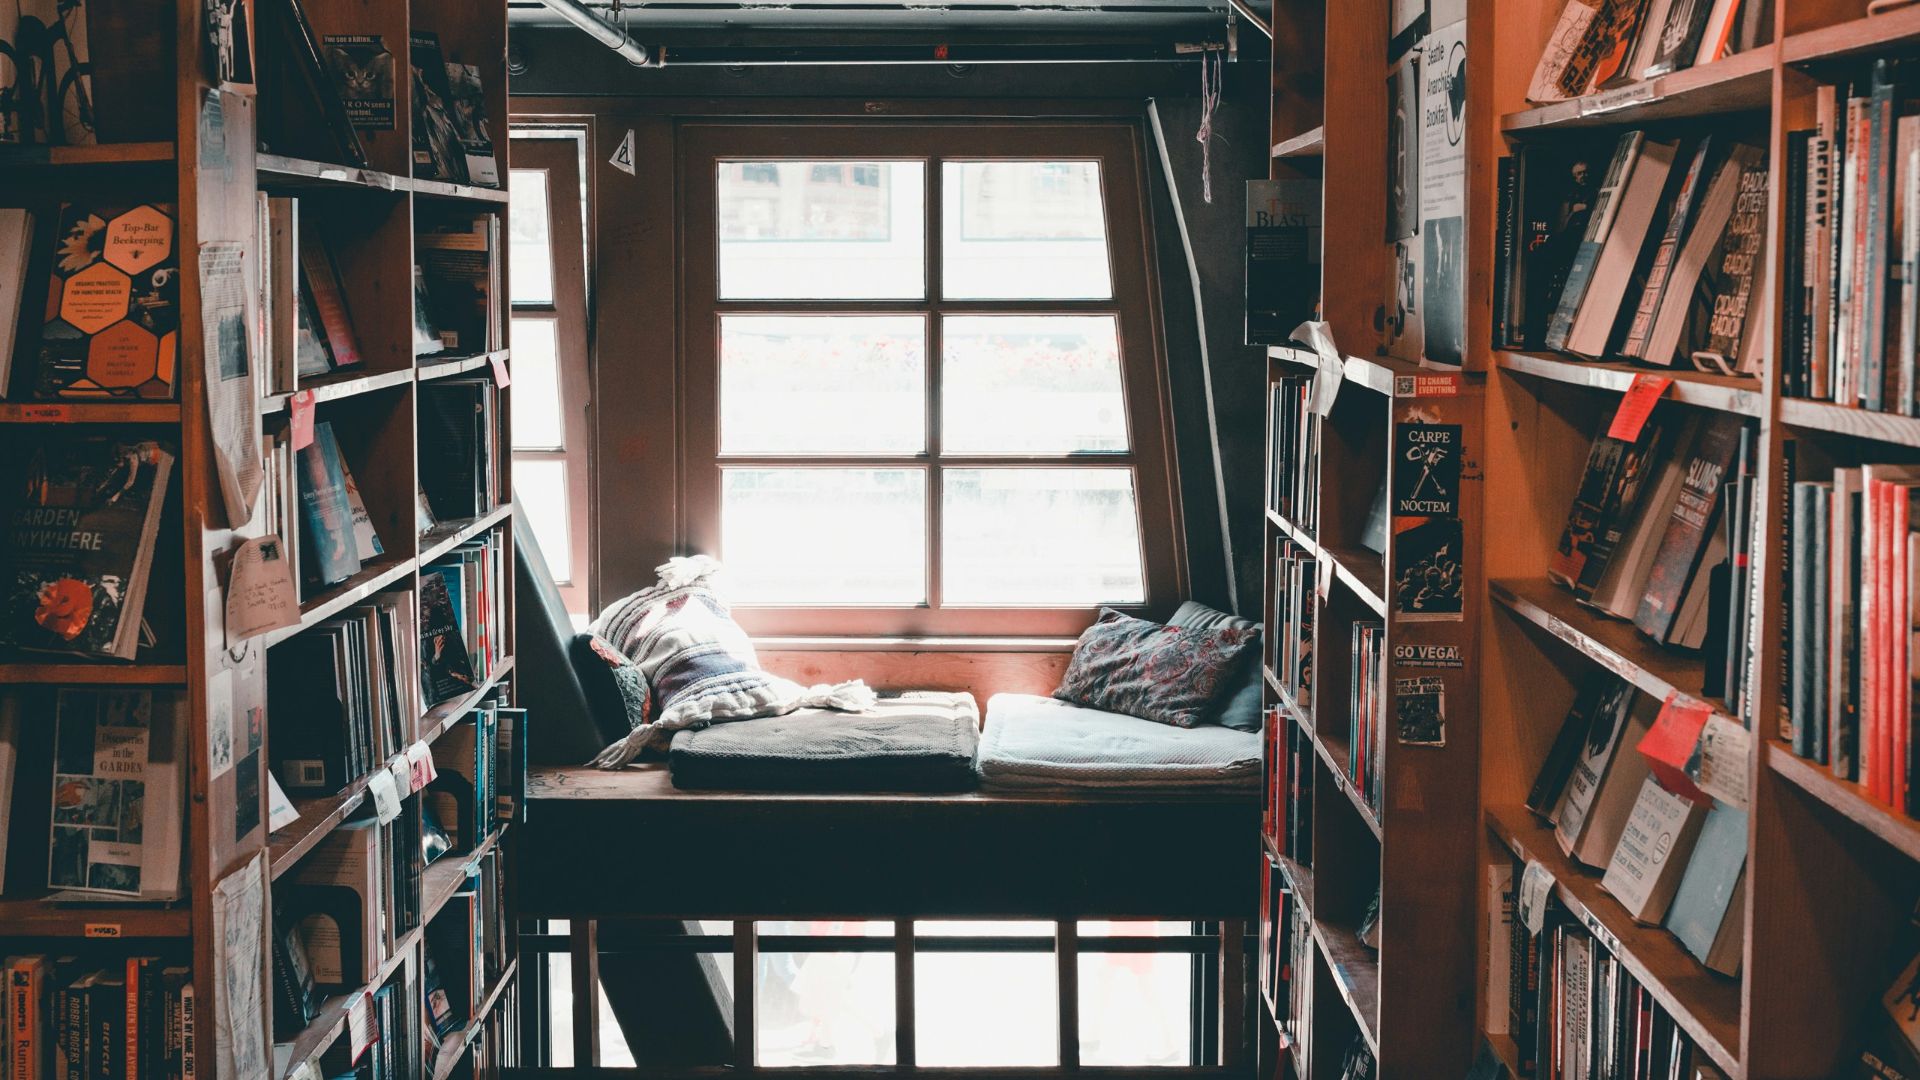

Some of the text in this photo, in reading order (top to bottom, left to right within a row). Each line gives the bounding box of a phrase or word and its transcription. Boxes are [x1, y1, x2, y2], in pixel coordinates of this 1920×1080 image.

[1428, 41, 1444, 66] Seattle
[1427, 70, 1454, 97] Anarchist
[1426, 104, 1448, 128] Bookfair
[1266, 198, 1304, 216] THE
[1256, 210, 1312, 228] BLAST
[1532, 222, 1548, 231] THE
[122, 223, 159, 234] Top-Bar
[113, 236, 164, 246] Beekeeping
[1418, 377, 1452, 386] TO CHANGE
[1418, 386, 1456, 394] EVERYTHING
[1408, 430, 1451, 443] CARPE
[1686, 456, 1722, 494] SLUMS
[1400, 500, 1450, 512] NOCTEM
[12, 508, 80, 527] GARDEN
[9, 530, 103, 550] ANYWHERE
[1395, 646, 1414, 658] GO
[1746, 656, 1754, 717] TORONTO
[102, 733, 144, 744] Discoveries
[113, 747, 134, 758] in the
[100, 761, 143, 772] GARDEN
[1641, 789, 1681, 820] LOCKING UP
[1626, 858, 1644, 880] America
[70, 997, 80, 1028] ROBBIE
[127, 992, 136, 1023] HEAVEN
[184, 997, 193, 1022] WHAT'S
[127, 1026, 136, 1034] IS
[184, 1024, 193, 1032] MY
[70, 1030, 80, 1064] ROGERS
[184, 1056, 193, 1076] FOOL?
